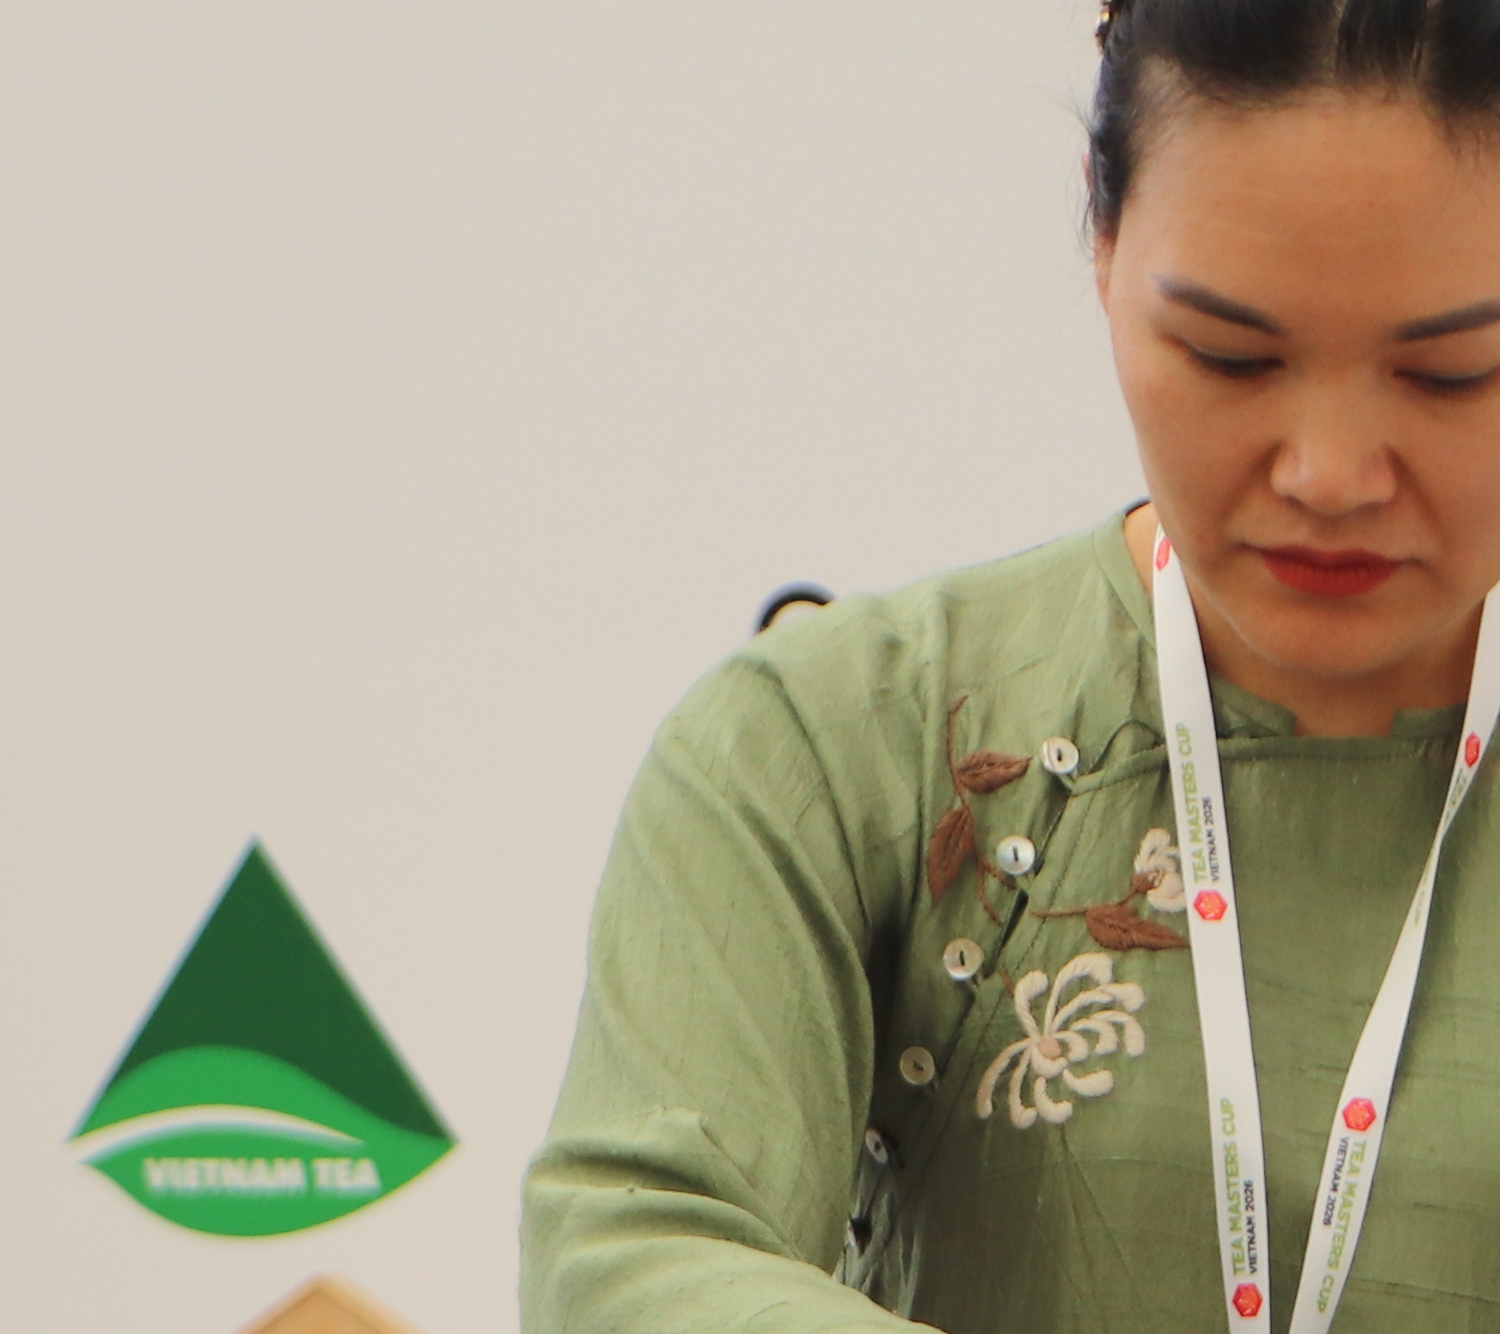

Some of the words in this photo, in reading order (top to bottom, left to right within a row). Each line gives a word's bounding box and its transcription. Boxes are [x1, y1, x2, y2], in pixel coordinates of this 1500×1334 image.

[1175, 722, 1193, 757] CUP
[1181, 760, 1204, 844] MASTERS
[1202, 795, 1215, 827] 2026
[1191, 845, 1208, 884] TEA
[1205, 828, 1220, 883] VIETNAM
[1220, 1097, 1237, 1137] CUP
[143, 1157, 309, 1194] VIETNAM
[311, 1157, 383, 1194] TEA
[1330, 1136, 1350, 1193] VIETNAM
[1347, 1139, 1367, 1177] TEA
[1223, 1139, 1245, 1233] MASTERS
[1242, 1178, 1255, 1212] 2026
[1244, 1214, 1259, 1275] VIETNAM
[1327, 1179, 1359, 1271] MASTERS
[1231, 1236, 1248, 1277] TEA
[1316, 1274, 1335, 1313] CUP
